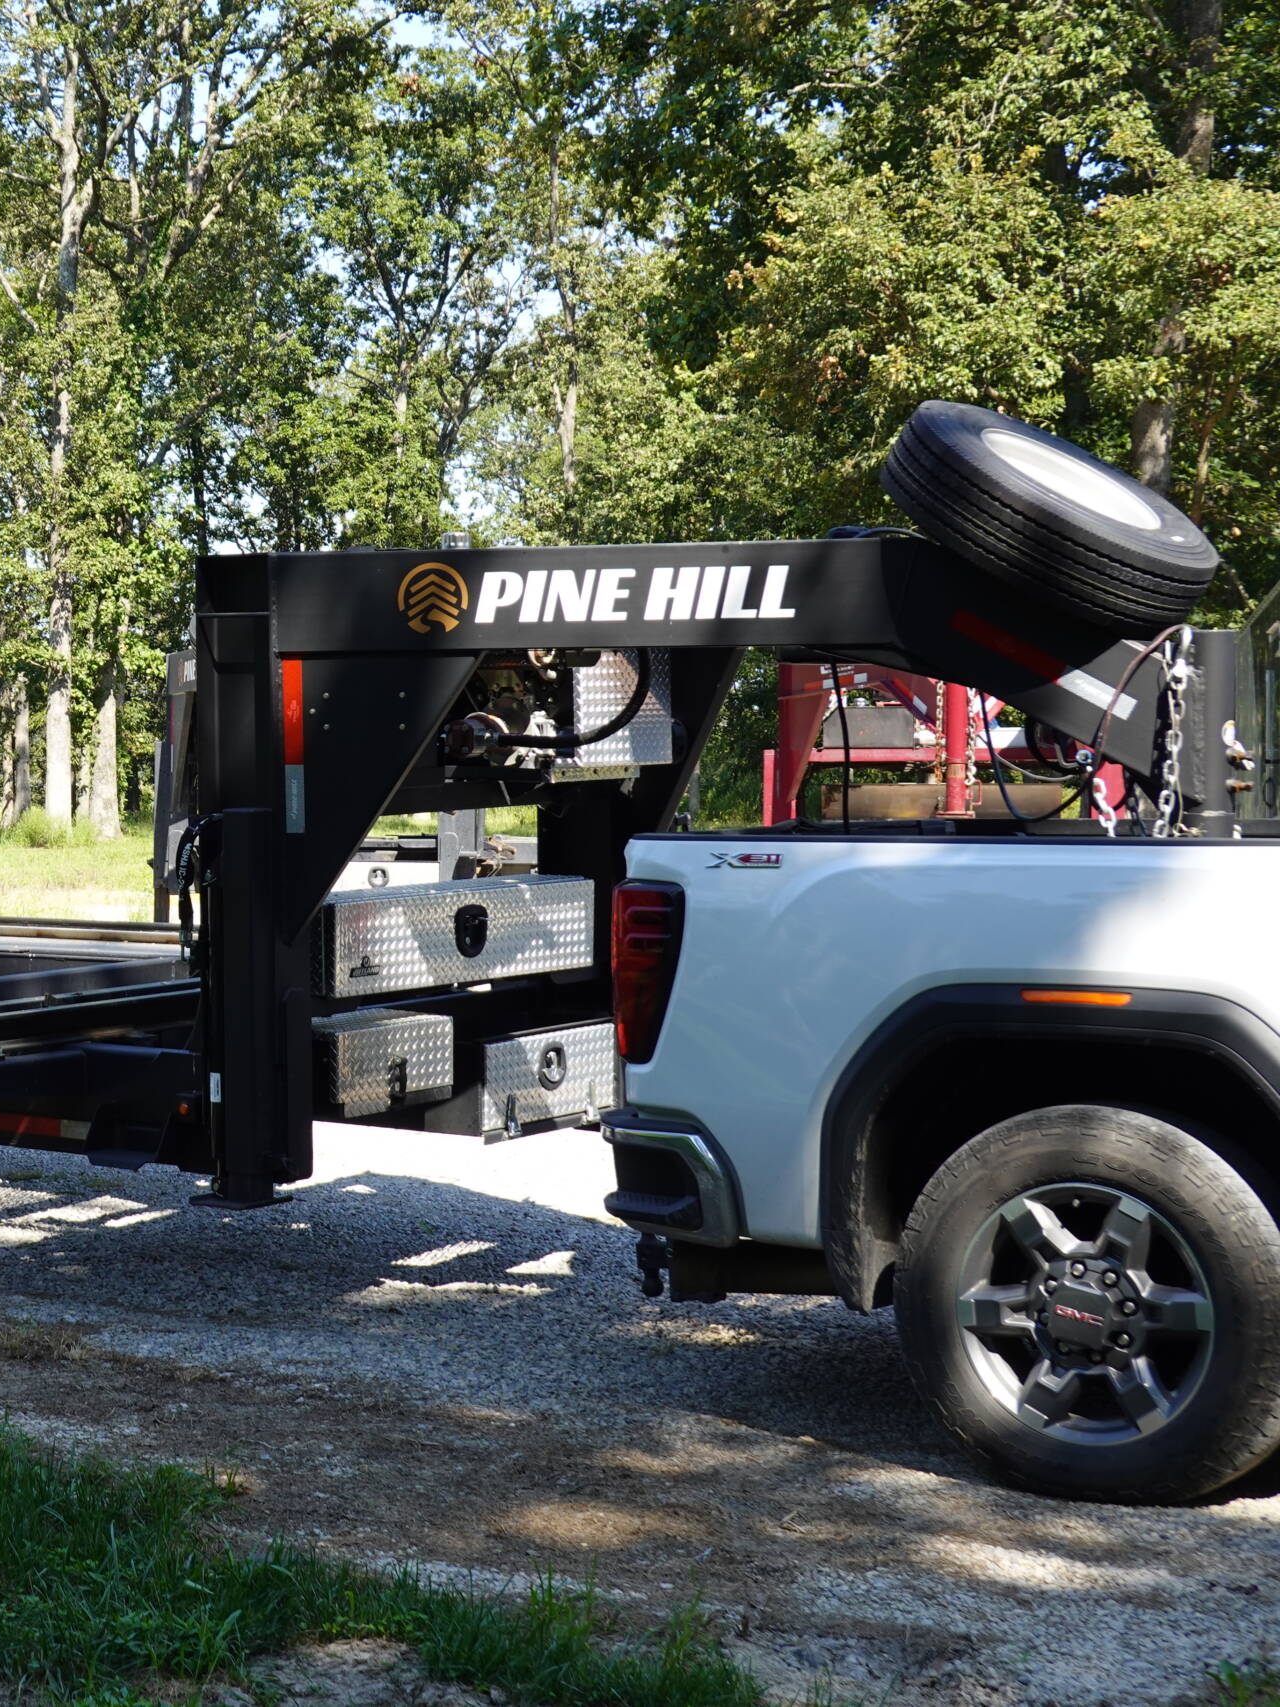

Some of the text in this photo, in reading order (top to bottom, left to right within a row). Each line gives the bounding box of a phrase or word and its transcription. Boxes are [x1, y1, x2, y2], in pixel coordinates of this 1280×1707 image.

[475, 565, 796, 623] PINE HILL
[1055, 1304, 1105, 1327] GMC
